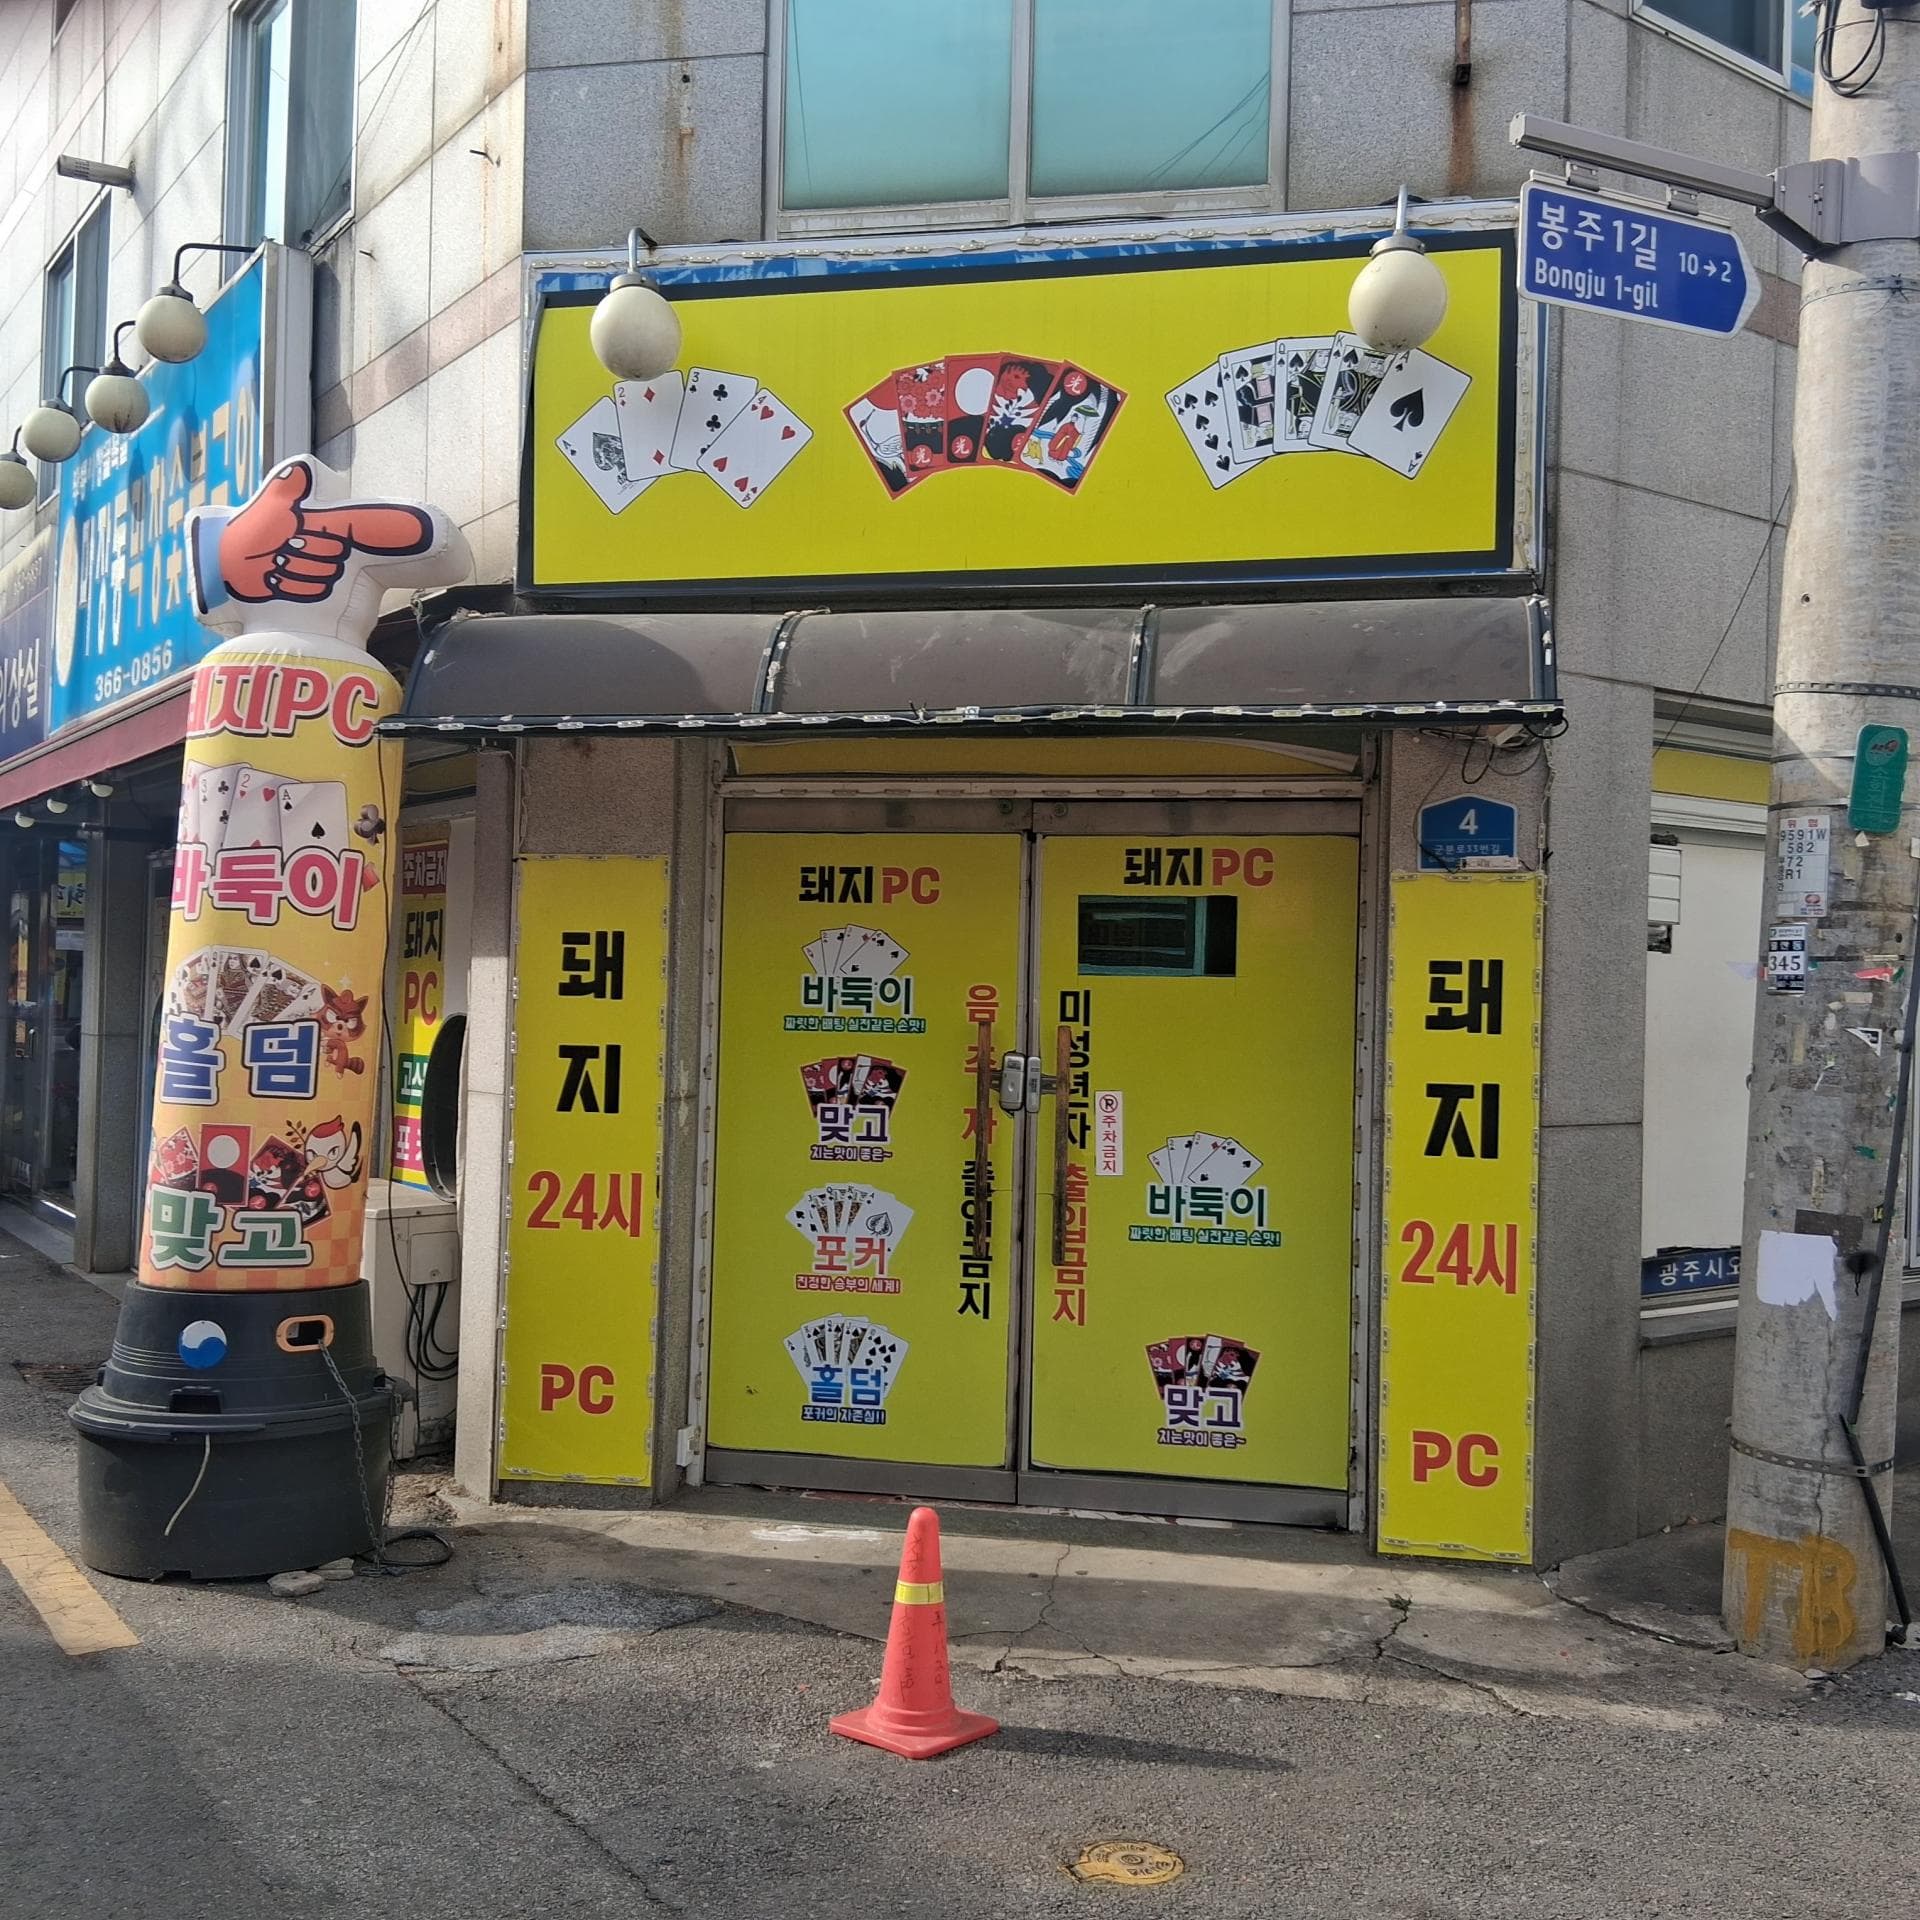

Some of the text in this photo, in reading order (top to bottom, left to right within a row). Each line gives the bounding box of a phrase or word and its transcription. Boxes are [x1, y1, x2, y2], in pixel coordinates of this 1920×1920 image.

[1537, 201, 1657, 271] 봉주1길
[1535, 258, 1658, 311] Bongju 1-gil
[95, 638, 174, 702] 366-0856
[1459, 808, 1479, 835] 4
[171, 844, 364, 930] 바둑이
[799, 865, 940, 904] 돼지 PC
[1124, 847, 1274, 887] 돼지 PC
[403, 908, 443, 960] 돼지
[1769, 955, 1801, 971] 345
[404, 971, 437, 1026] PC
[558, 930, 625, 1114] 돼지
[803, 976, 912, 1015] 바둑이
[161, 1016, 319, 1103] 홀덤
[1424, 959, 1504, 1160] 돼지
[820, 1106, 888, 1142] 맞고
[1102, 1115, 1117, 1173] 주차금지
[150, 1184, 313, 1269] 맞고
[527, 1170, 643, 1238] 24시
[1150, 1185, 1264, 1227] 바둑이
[815, 1235, 885, 1275] 포커
[1400, 1220, 1518, 1295] 24시
[540, 1363, 614, 1415] PC
[811, 1364, 881, 1406] 홀덤
[1167, 1388, 1241, 1428] 맞고
[1412, 1430, 1499, 1488] PC
